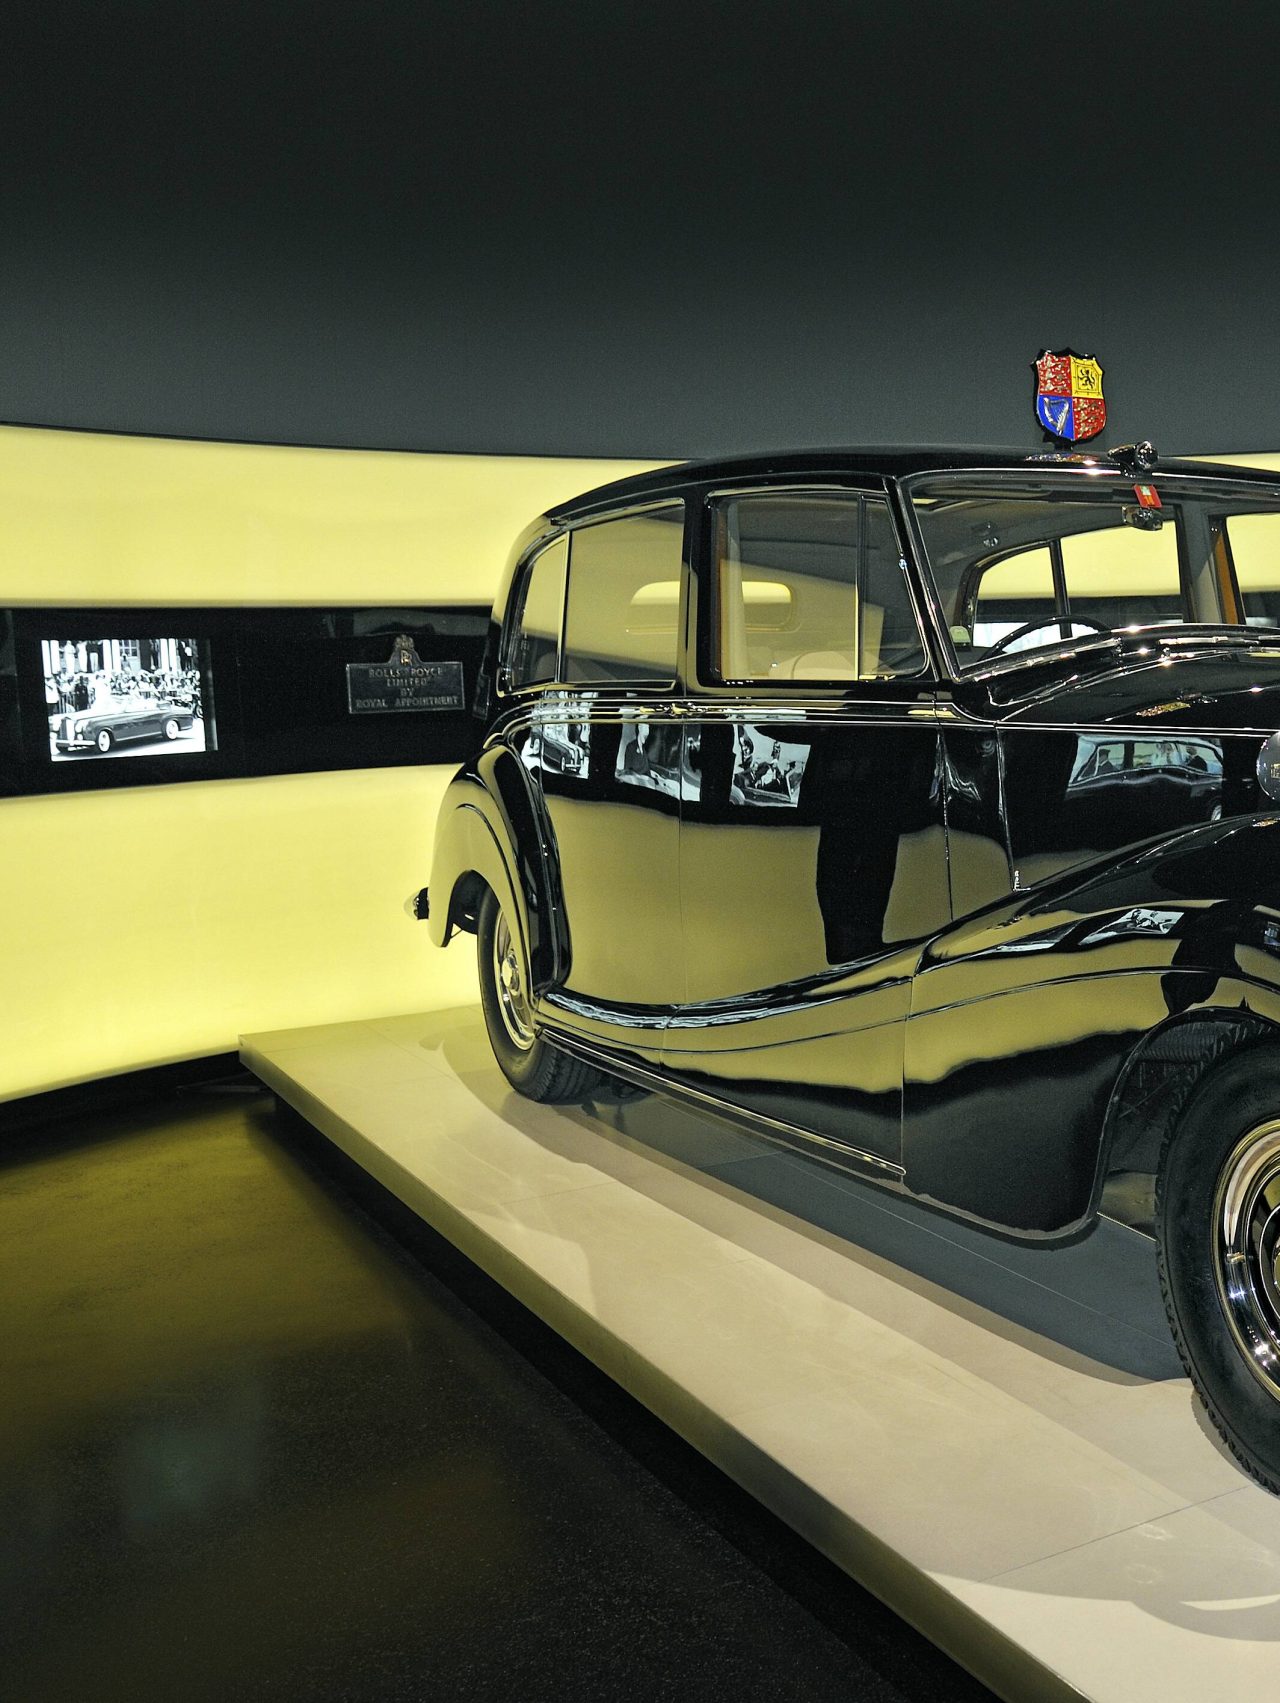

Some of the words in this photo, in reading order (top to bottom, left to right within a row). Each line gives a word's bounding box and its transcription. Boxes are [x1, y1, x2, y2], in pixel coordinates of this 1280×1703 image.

[369, 669, 401, 678] ROLLS
[411, 667, 444, 677] ROYCE
[387, 678, 427, 687] LIMITED
[400, 688, 414, 696] BY
[356, 699, 388, 708] ROYAL
[394, 696, 458, 707] APPOINTMENT
